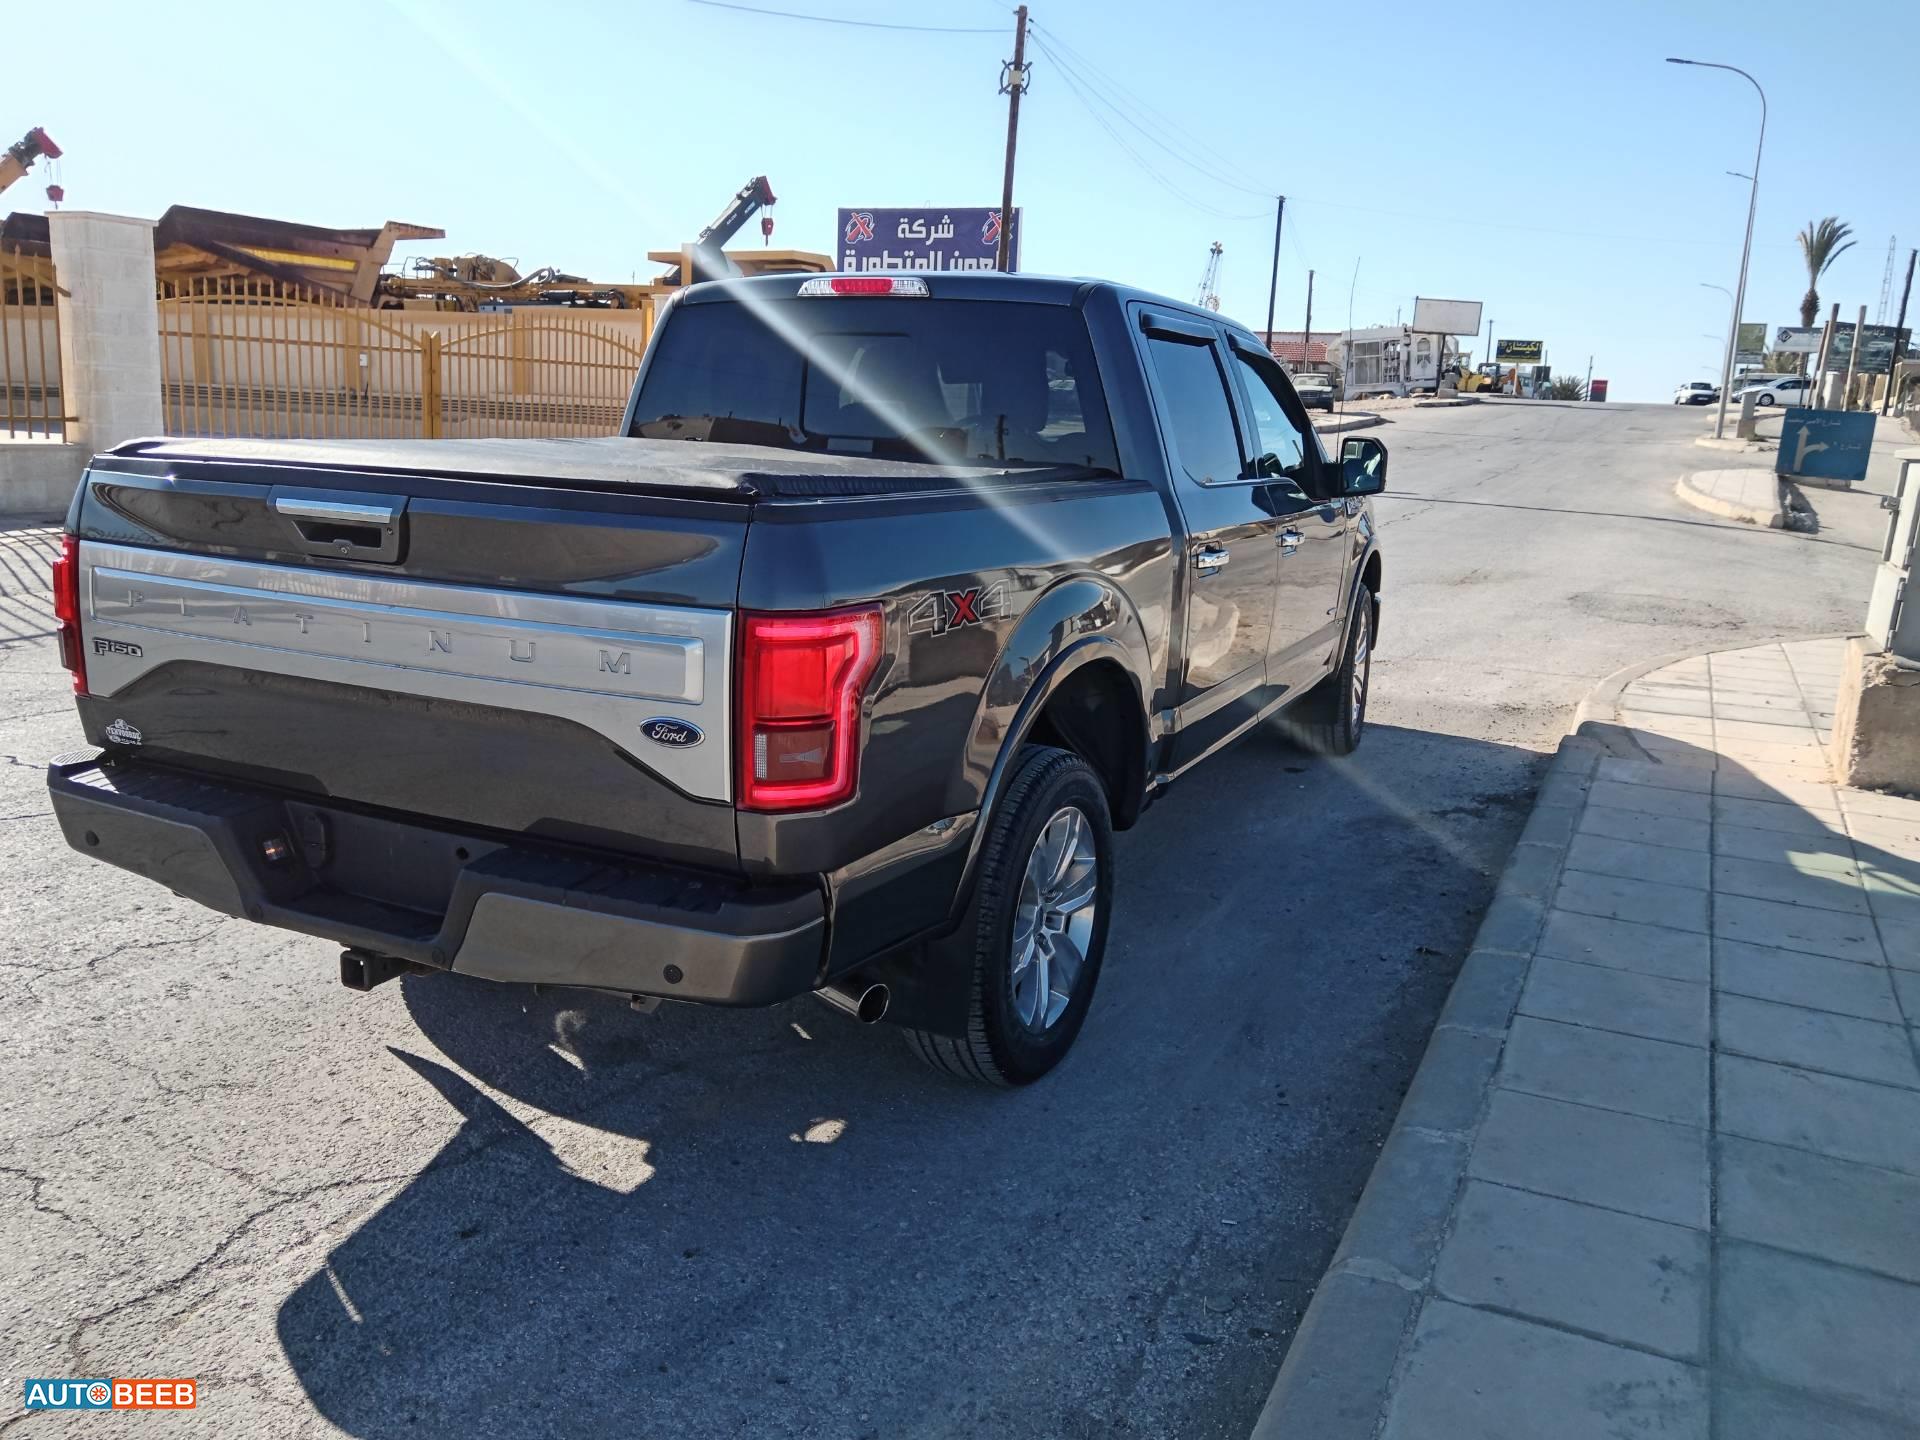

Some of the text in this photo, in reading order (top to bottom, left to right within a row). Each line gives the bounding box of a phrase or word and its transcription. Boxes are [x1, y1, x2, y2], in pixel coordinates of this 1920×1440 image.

[897, 214, 954, 246] شركة
[126, 589, 633, 676] PLATINUM
[651, 722, 688, 743] Ford
